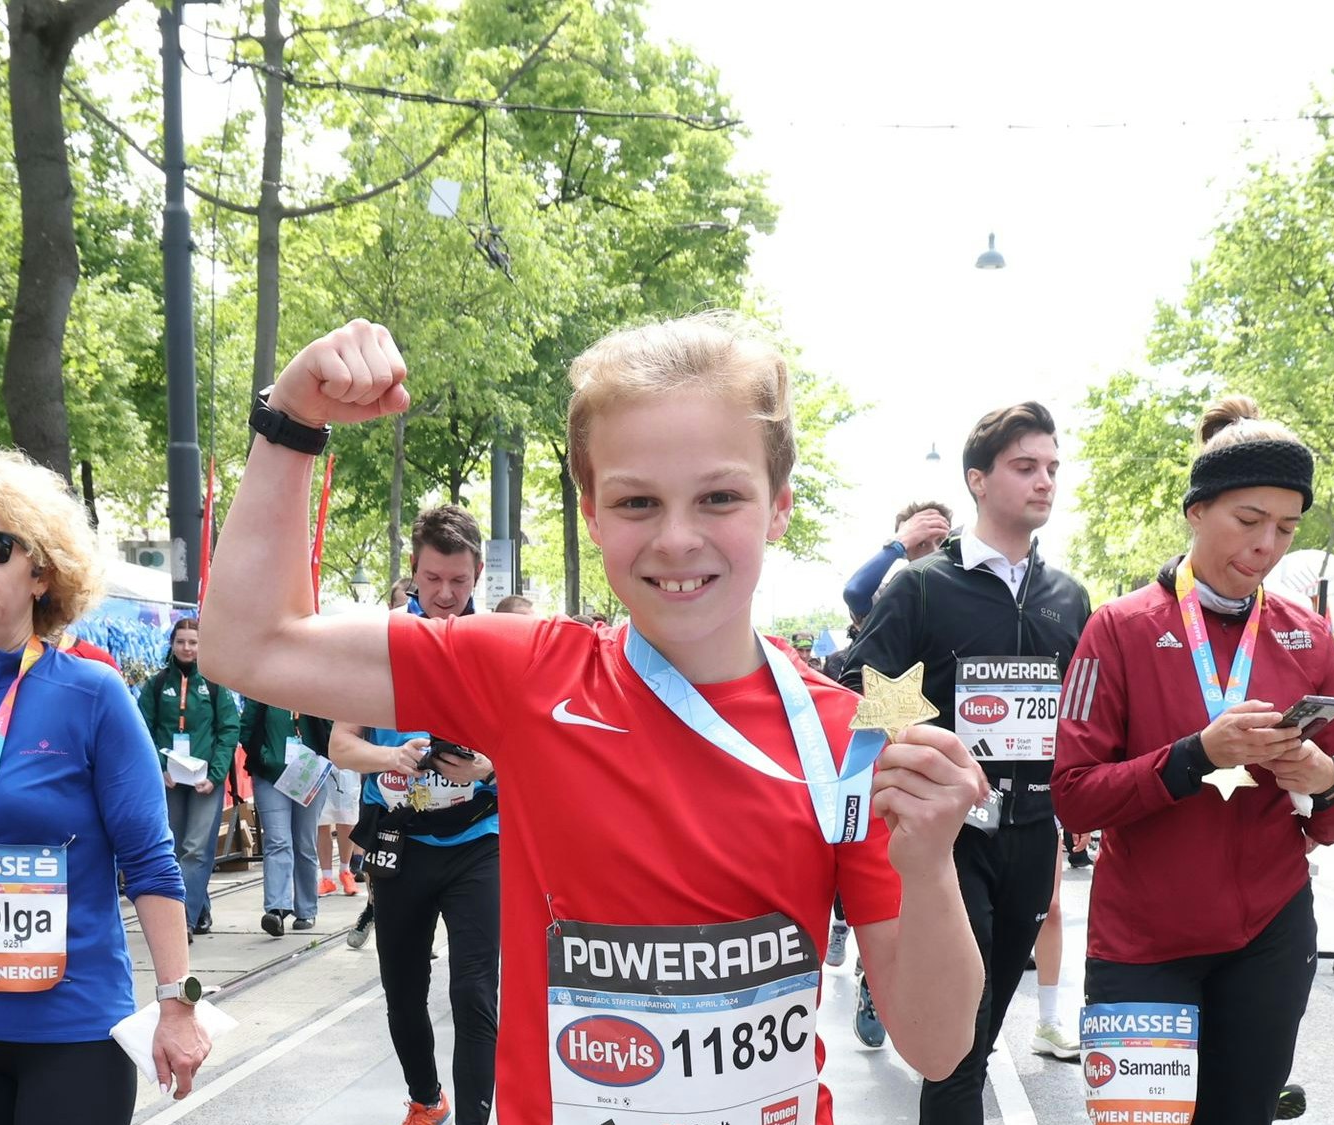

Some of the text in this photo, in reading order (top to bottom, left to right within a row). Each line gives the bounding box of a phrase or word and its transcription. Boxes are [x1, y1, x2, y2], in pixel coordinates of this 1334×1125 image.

[1040, 607, 1062, 620] GORE
[1186, 602, 1203, 641] MARATHON
[1155, 640, 1183, 649] adidas
[963, 663, 1059, 680] POWERADE
[964, 702, 1006, 718] Hervis
[1014, 697, 1058, 720] 728D
[384, 772, 408, 786] Herv
[378, 831, 400, 843] STORY!
[563, 924, 805, 981] POWERADE
[575, 995, 611, 1005] POWERADE
[611, 997, 678, 1010] STAFFELMARATHON
[695, 999, 718, 1009] APRIL
[719, 997, 740, 1006] 2024
[1082, 1014, 1174, 1035] SPARKASSE
[672, 1004, 809, 1078] 1183C
[568, 1027, 655, 1073] Hervis
[1119, 1058, 1191, 1077] Samantha
[1149, 1087, 1166, 1095] 6121
[597, 1095, 612, 1105] Block
[762, 1104, 798, 1125] Kronen
[1096, 1110, 1190, 1125] WIEN ENERGIE
